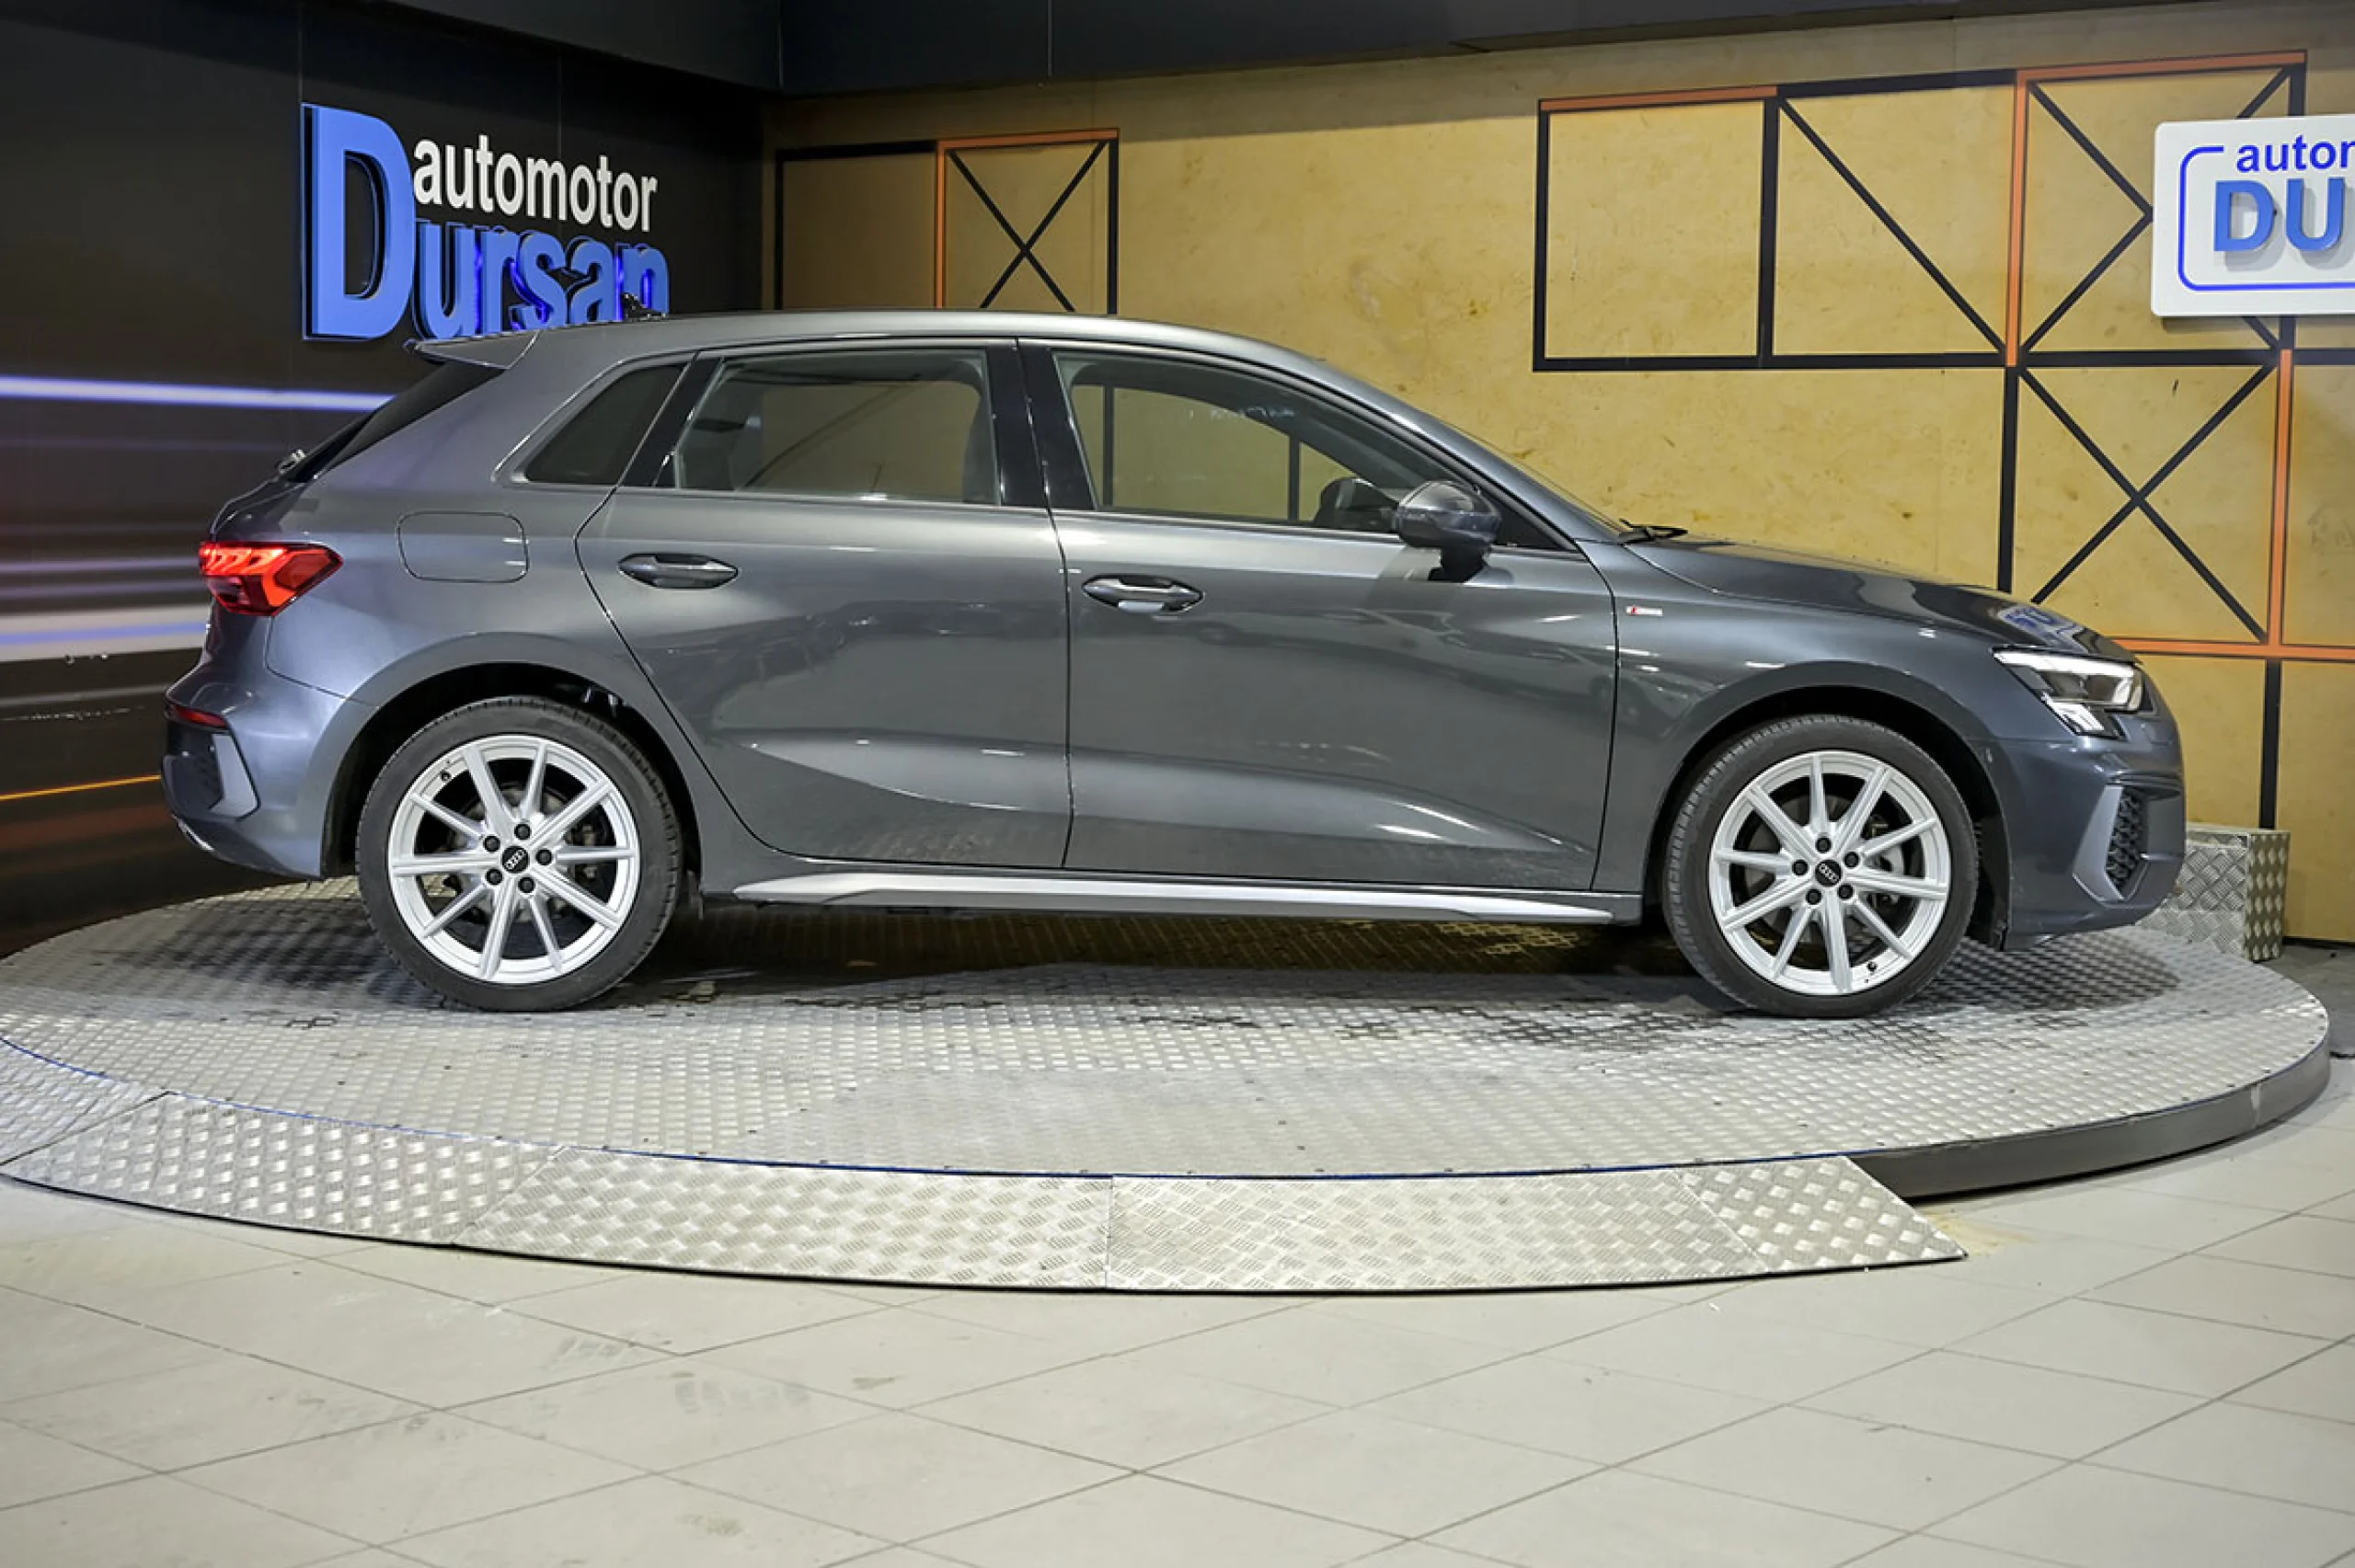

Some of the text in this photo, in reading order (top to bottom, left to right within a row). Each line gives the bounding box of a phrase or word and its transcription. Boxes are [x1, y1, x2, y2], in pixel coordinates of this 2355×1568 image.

[302, 102, 670, 340] Dursan
[413, 133, 659, 233] automotor
[2213, 177, 2346, 253] DU
